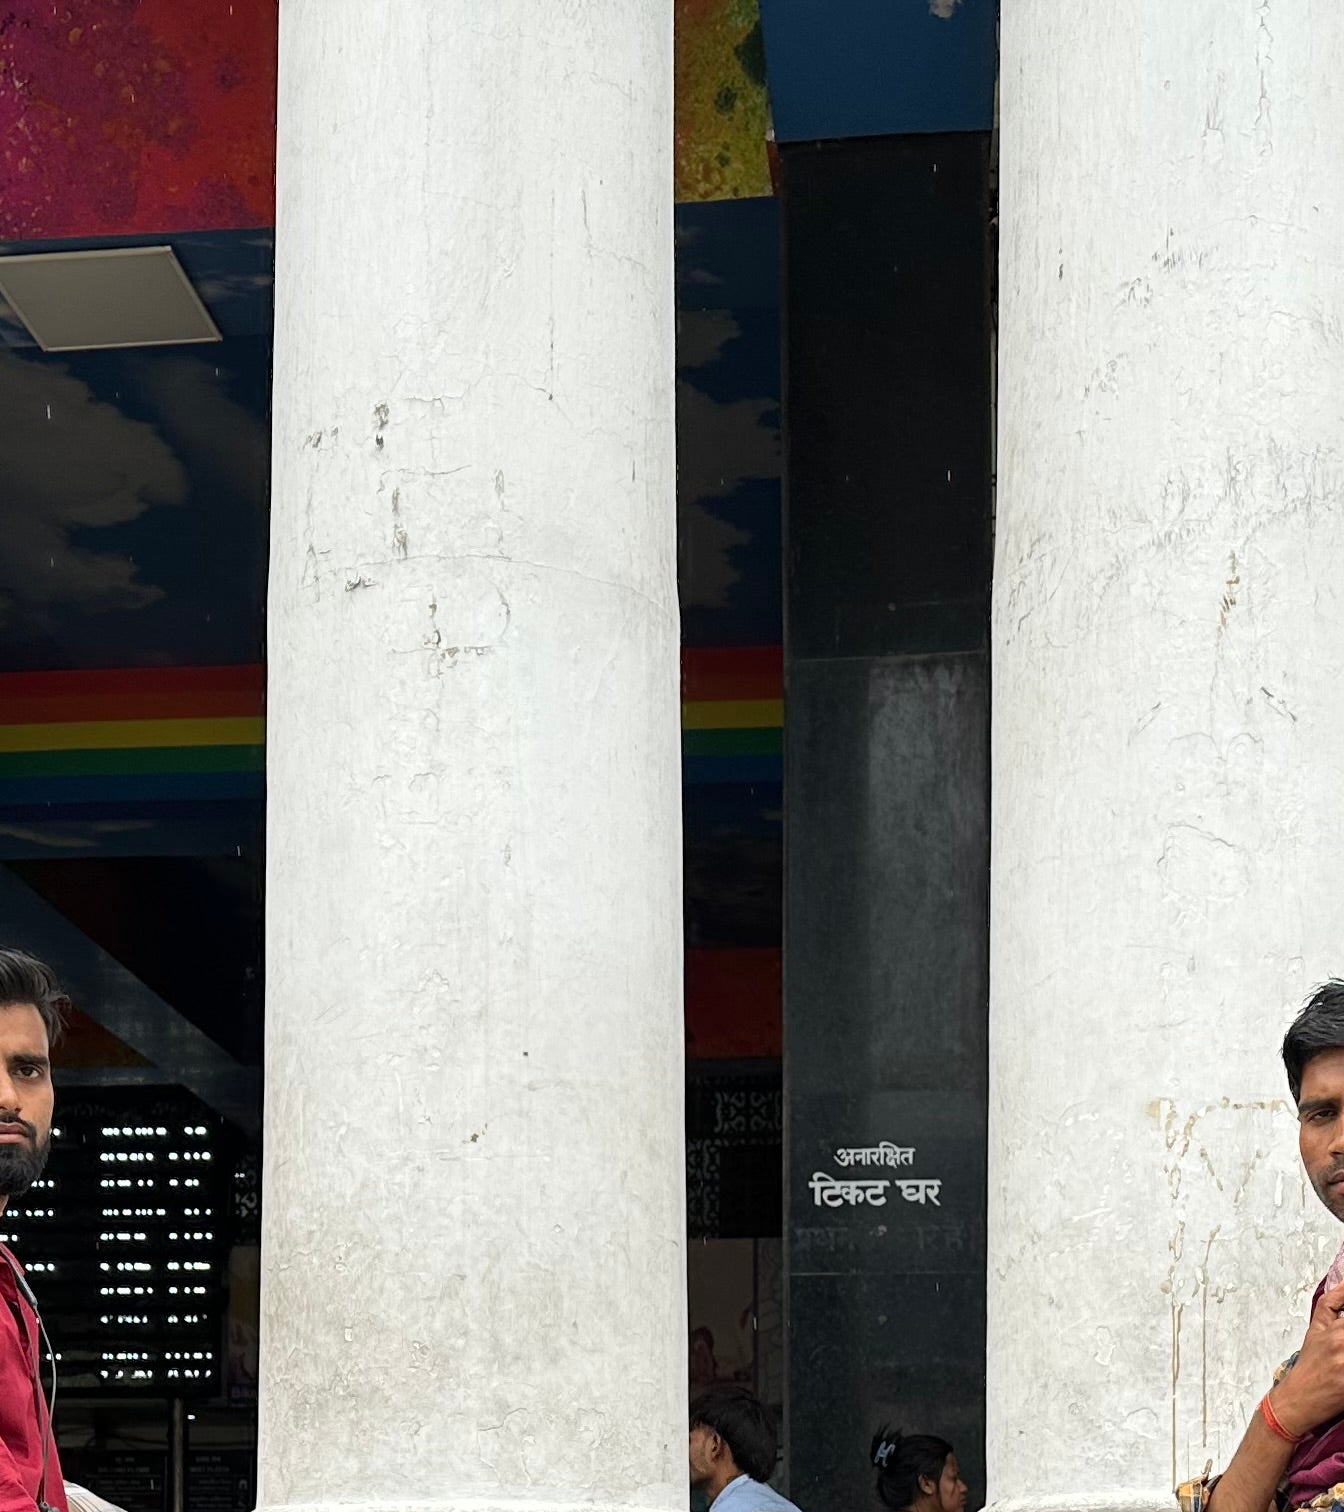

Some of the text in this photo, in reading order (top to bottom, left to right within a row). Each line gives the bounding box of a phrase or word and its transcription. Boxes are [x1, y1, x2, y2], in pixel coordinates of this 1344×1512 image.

[834, 1141, 916, 1168] अनारक्षित
[808, 1171, 942, 1207] टिकट घर
